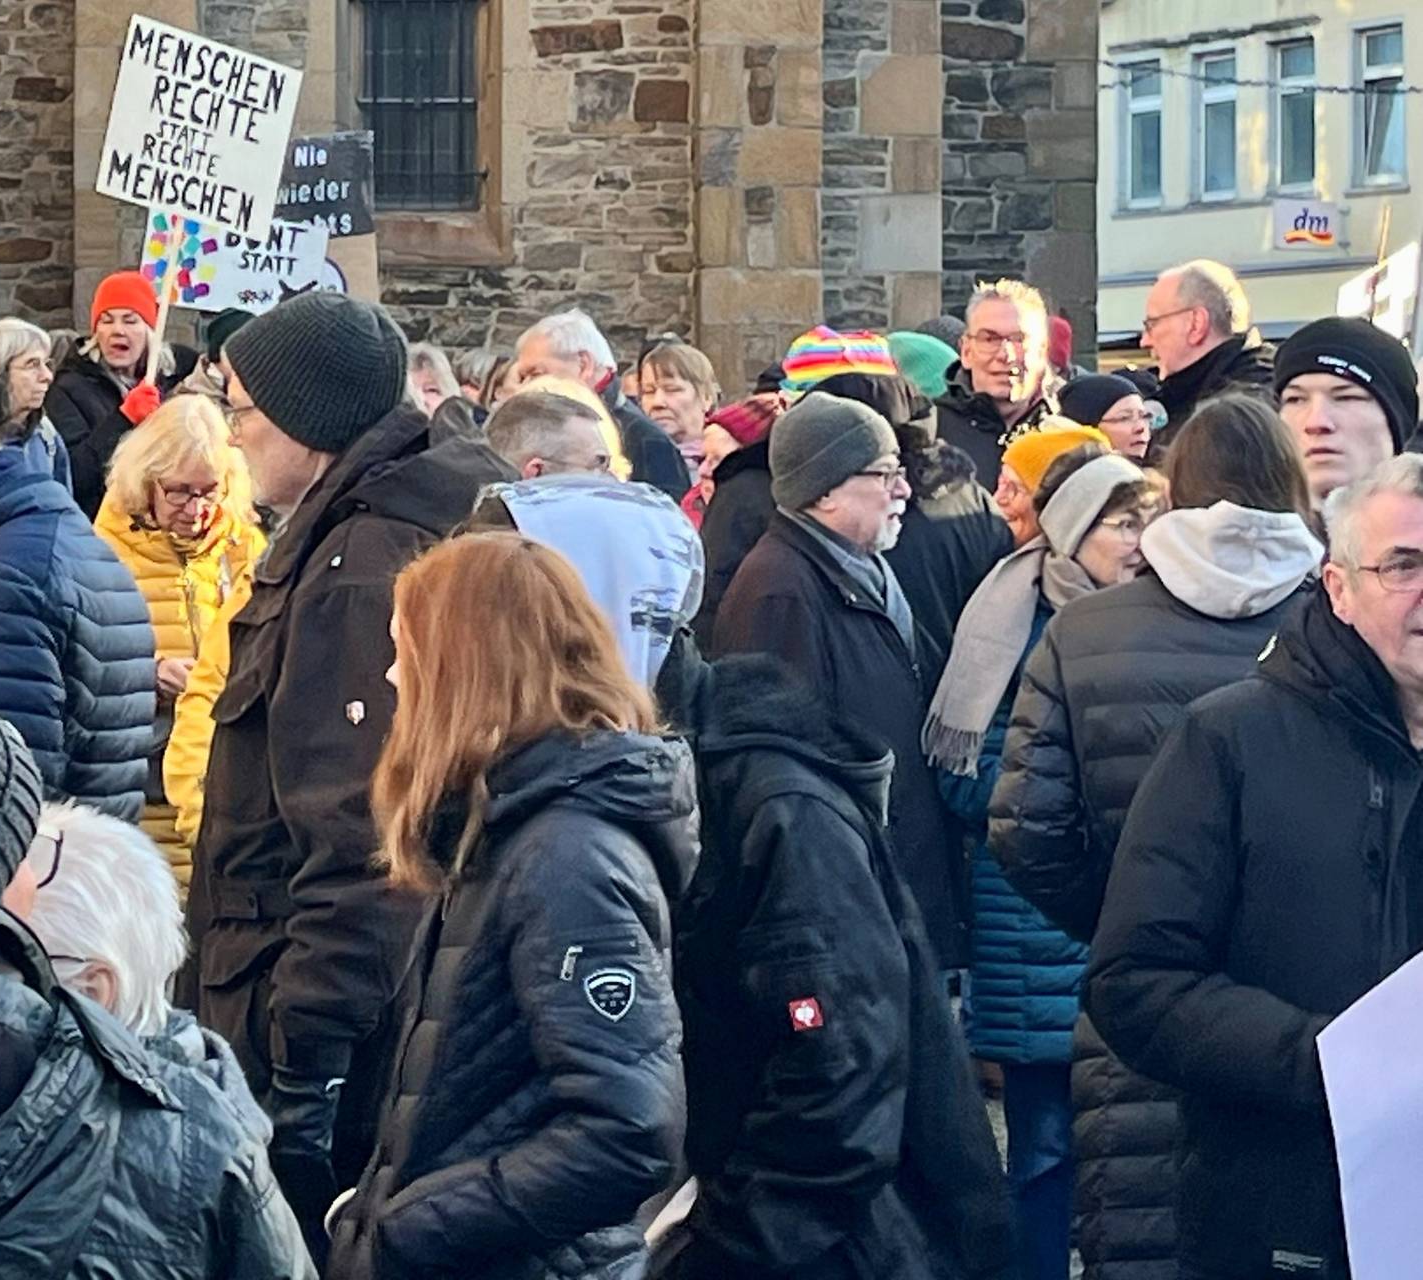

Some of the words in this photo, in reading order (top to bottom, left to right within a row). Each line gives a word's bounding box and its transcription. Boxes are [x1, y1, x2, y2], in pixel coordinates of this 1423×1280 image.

[129, 23, 286, 114] MENSCHEN
[151, 75, 268, 144] RECHTE
[140, 133, 222, 178] RECHTE
[156, 120, 214, 151] STATT
[106, 149, 255, 232] MENSCHEN
[1293, 207, 1329, 233] dm
[237, 250, 299, 277] STATT
